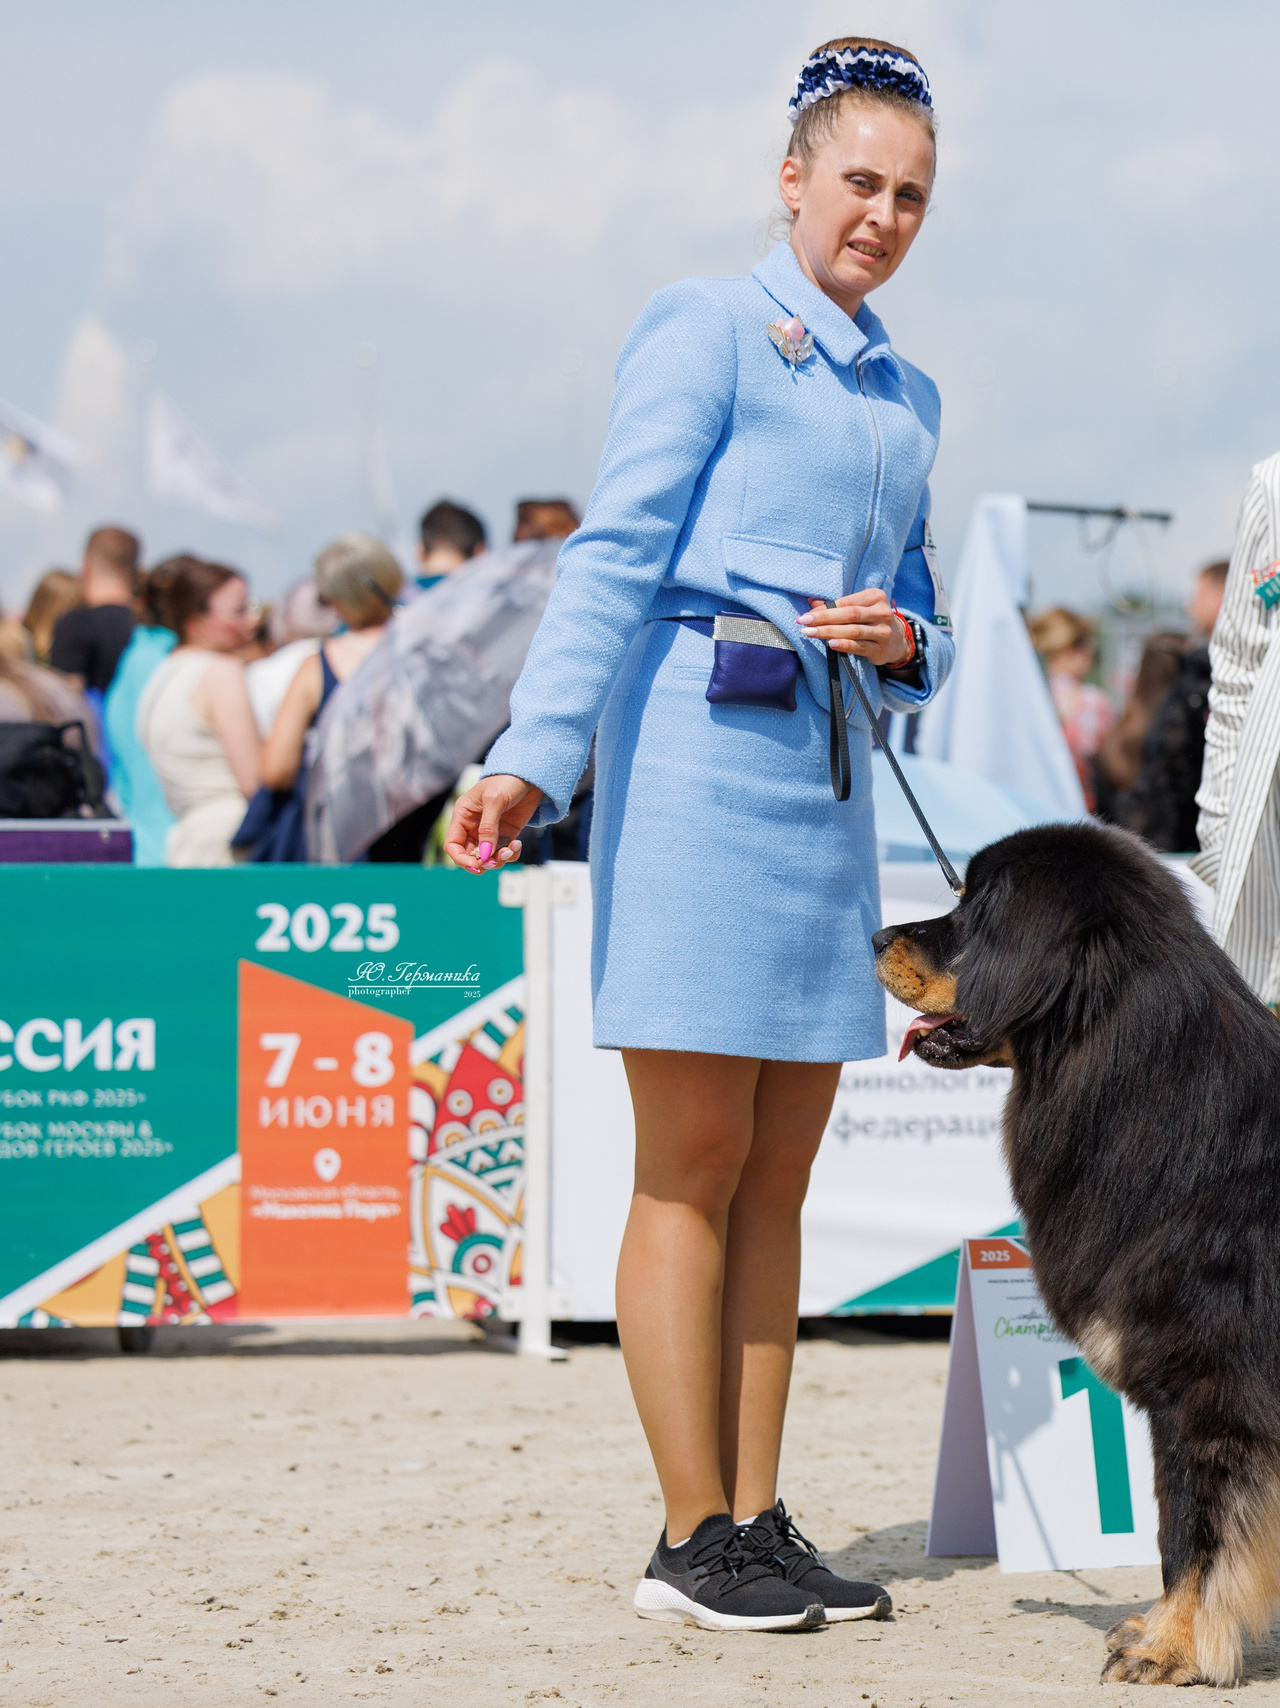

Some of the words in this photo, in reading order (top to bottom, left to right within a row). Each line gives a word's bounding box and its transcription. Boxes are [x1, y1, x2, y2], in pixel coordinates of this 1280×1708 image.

[255, 902, 400, 952] 2025
[259, 1031, 301, 1088] 7
[351, 1031, 395, 1088] 8
[47, 1089, 89, 1107] РКФ
[258, 1094, 395, 1129] ИЮНЯ
[47, 1120, 135, 1139] МОСКВЫ
[980, 1250, 1011, 1262] 2025
[1058, 1355, 1135, 1535] 1
